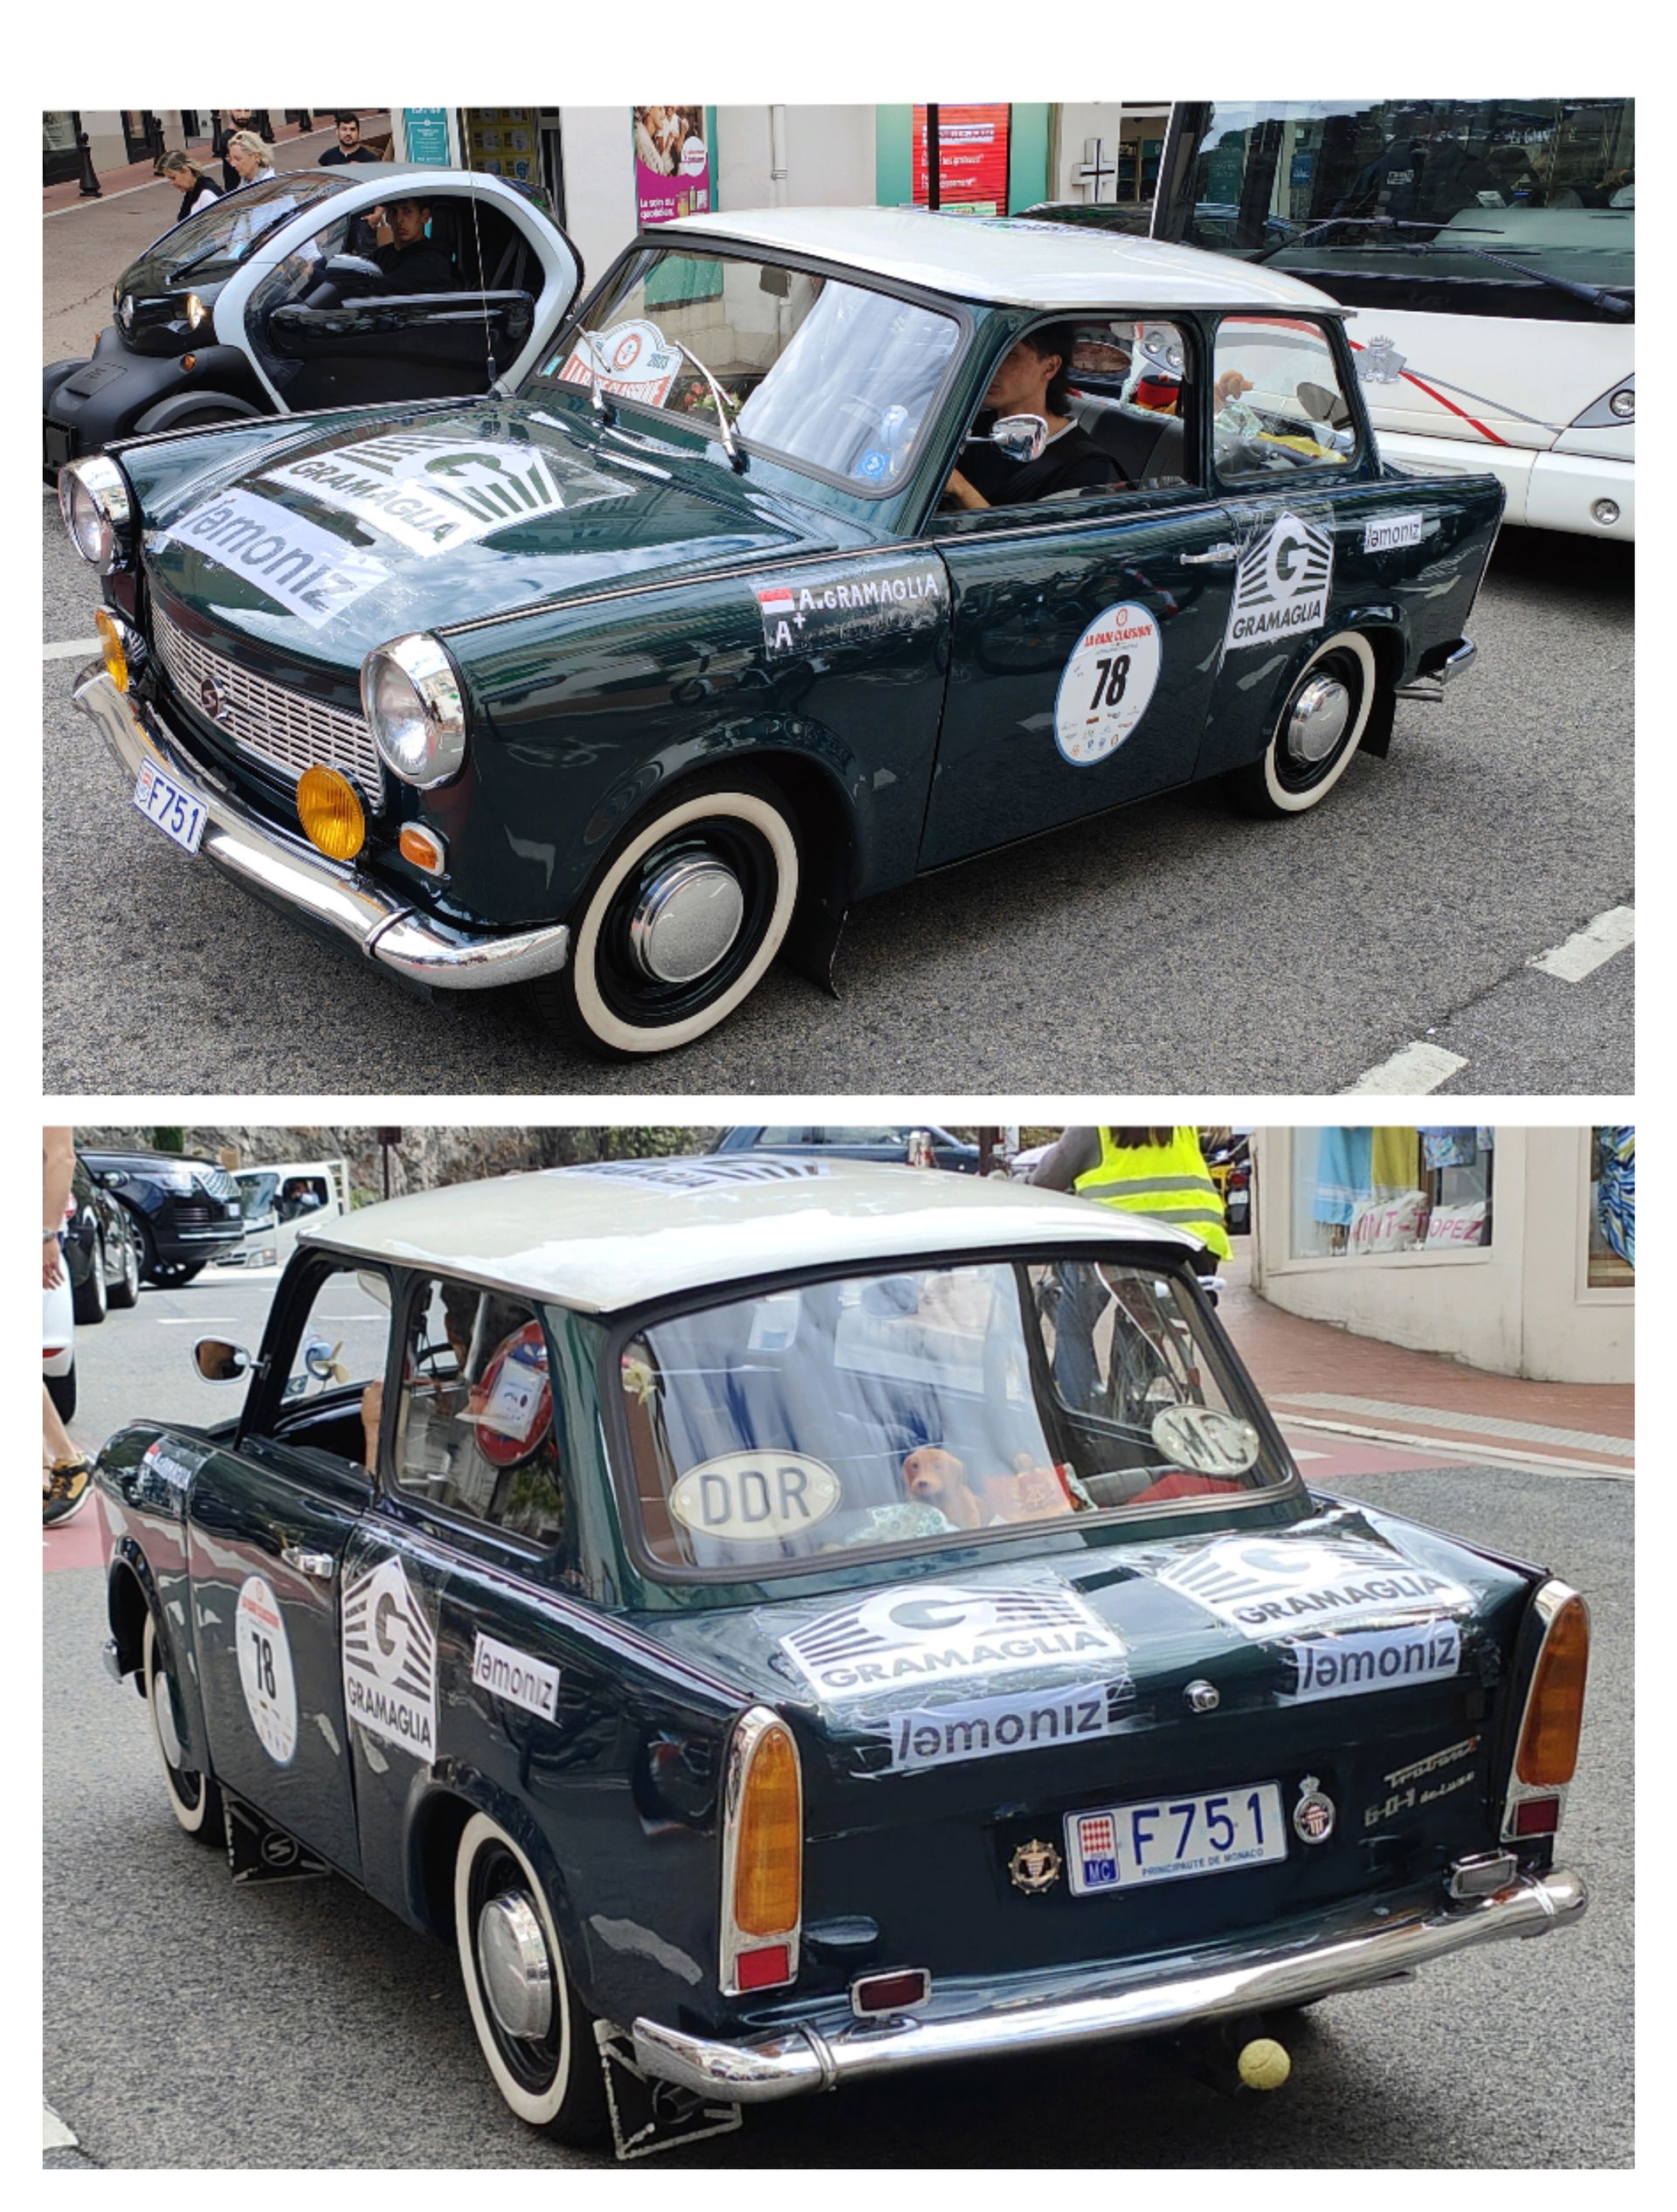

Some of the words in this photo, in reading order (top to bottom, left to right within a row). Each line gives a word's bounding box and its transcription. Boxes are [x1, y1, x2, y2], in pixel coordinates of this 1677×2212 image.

[289, 460, 464, 543] GRAMAGLIA
[1232, 599, 1321, 639] GRAMAGLIA
[1089, 654, 1131, 710] 78
[148, 776, 199, 844] F751
[1164, 1414, 1248, 1468] MC
[700, 1466, 811, 1526] DDR
[1231, 1575, 1449, 1624] GRAMAGLIA
[252, 1631, 276, 1700] 78
[820, 1631, 1109, 1688] GRAMAGLIA
[348, 1676, 432, 1749] GRAMAGLIA
[1131, 1792, 1265, 1866] F751
[1208, 1856, 1221, 1867] DE
[1224, 1848, 1264, 1863] MONACO
[1088, 1862, 1111, 1881] MC
